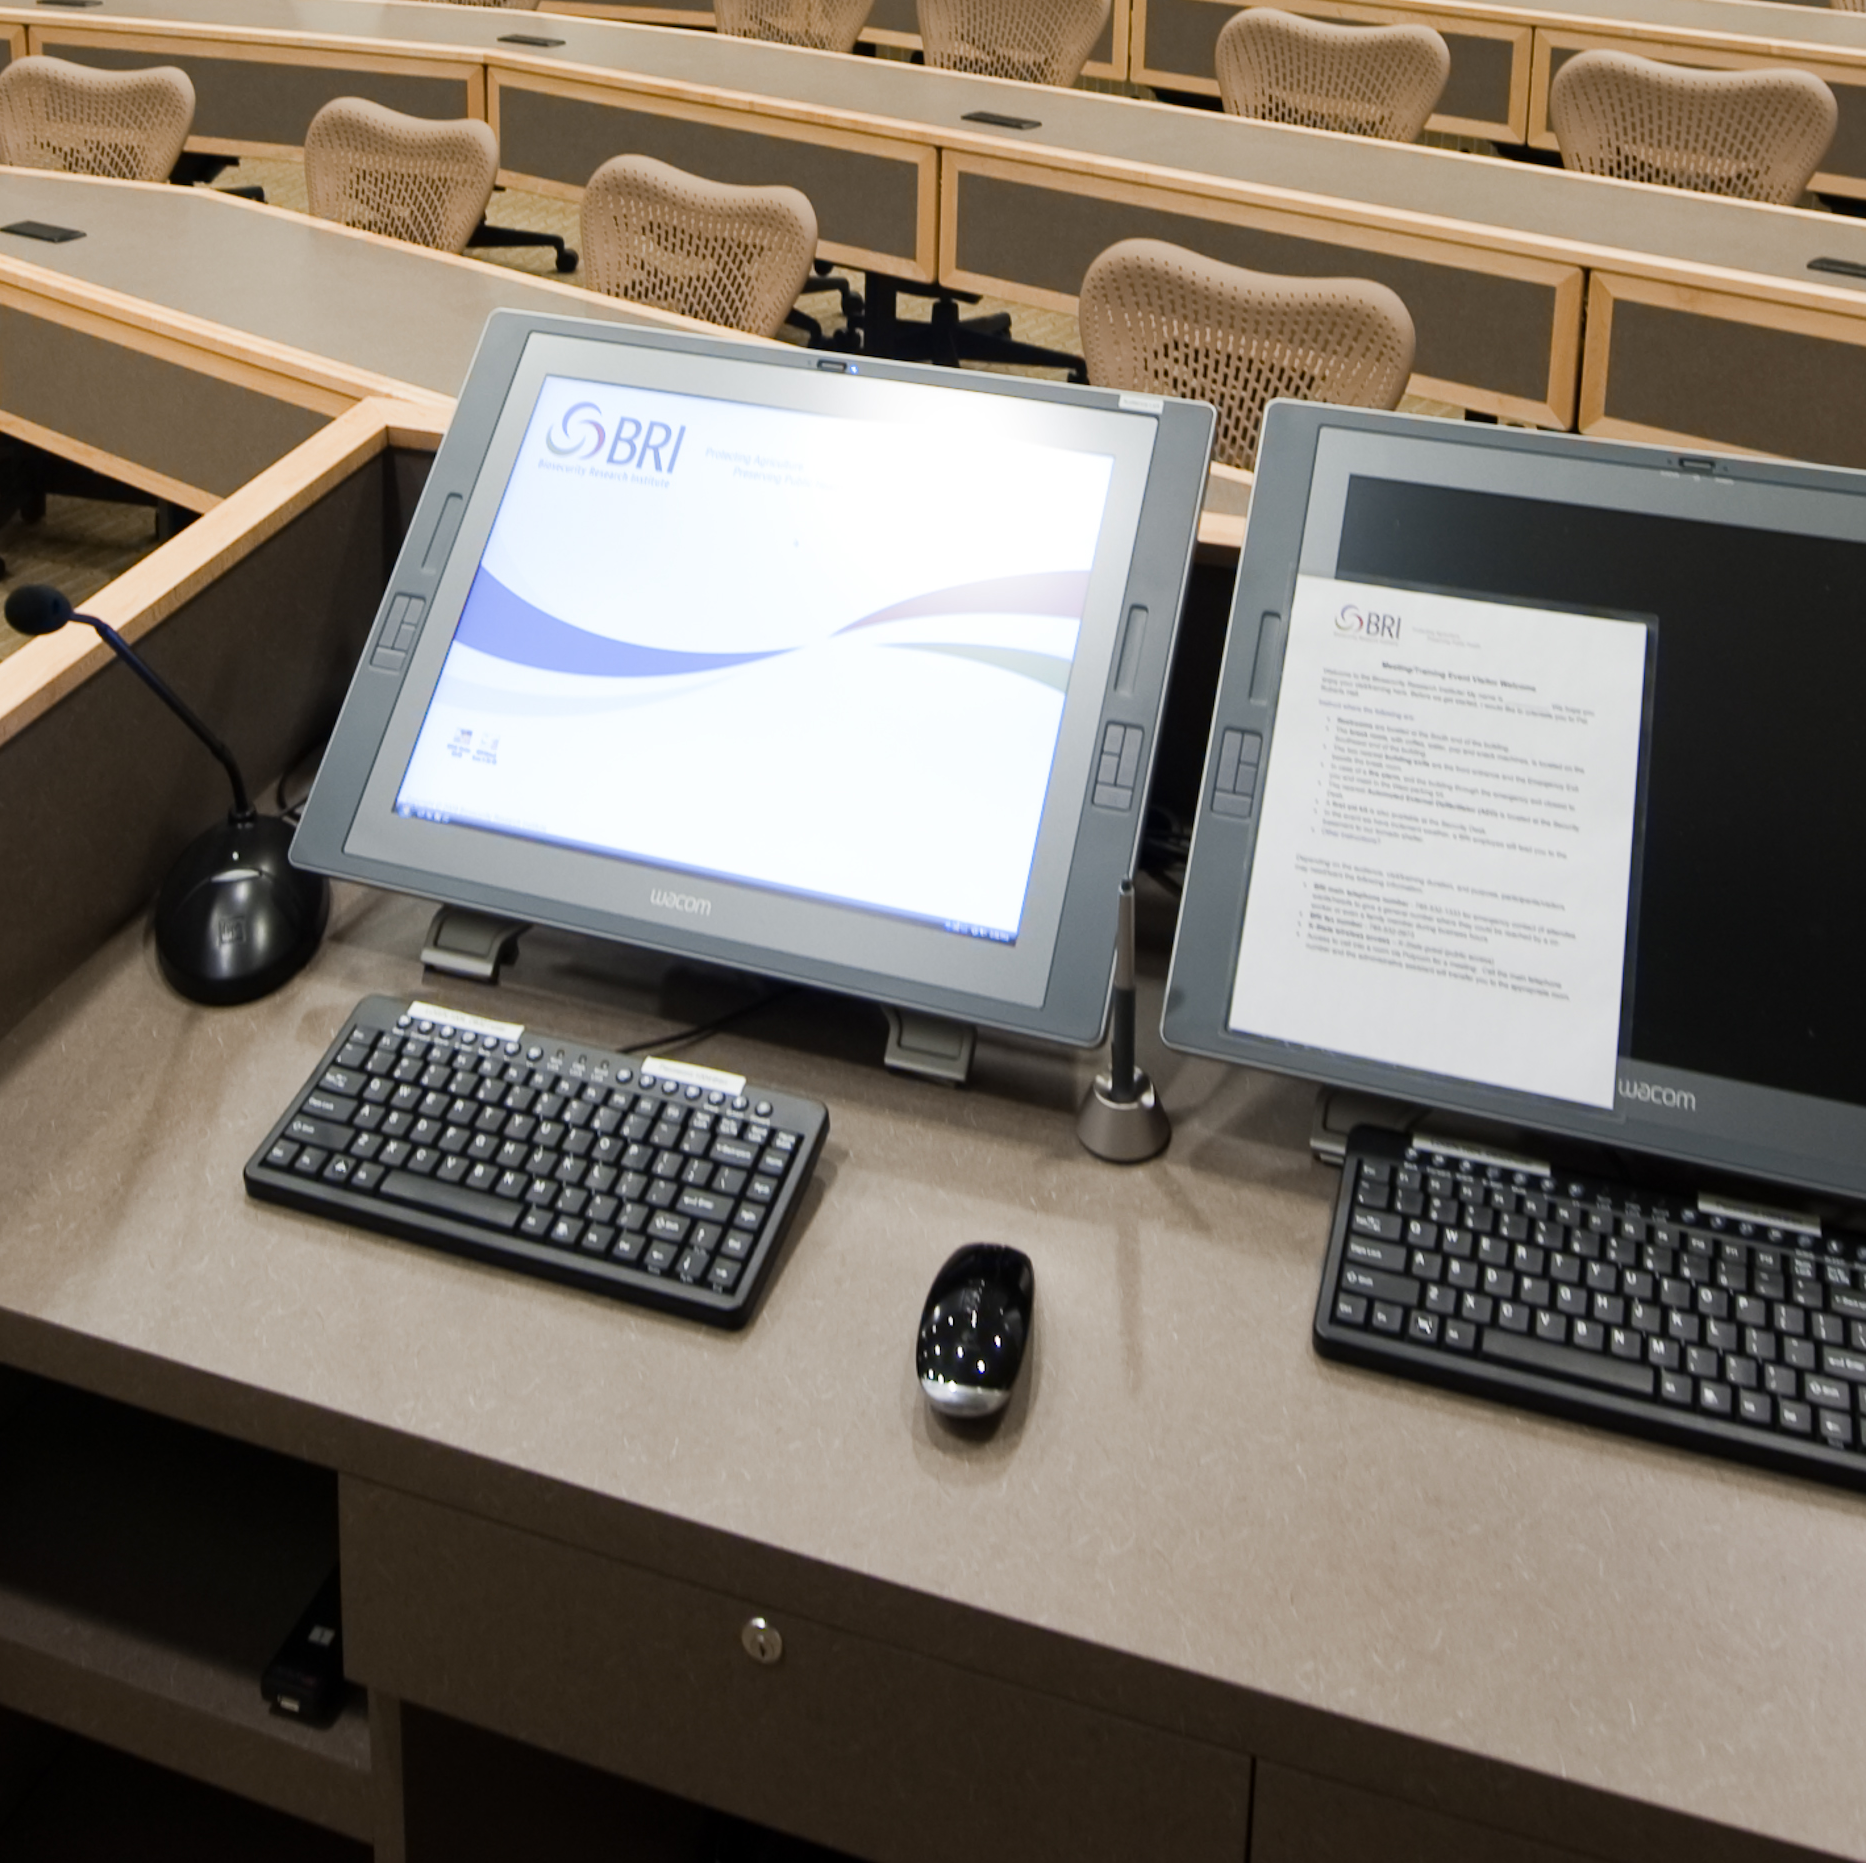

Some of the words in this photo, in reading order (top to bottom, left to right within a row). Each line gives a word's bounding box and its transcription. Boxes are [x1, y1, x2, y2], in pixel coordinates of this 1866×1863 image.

[606, 416, 686, 474] BRI
[537, 458, 586, 477] Biosecurity
[589, 466, 628, 482] Research
[631, 472, 670, 489] Institute
[1366, 611, 1402, 640] BRI
[649, 887, 712, 917] wacom
[1618, 1078, 1696, 1112] wacom
